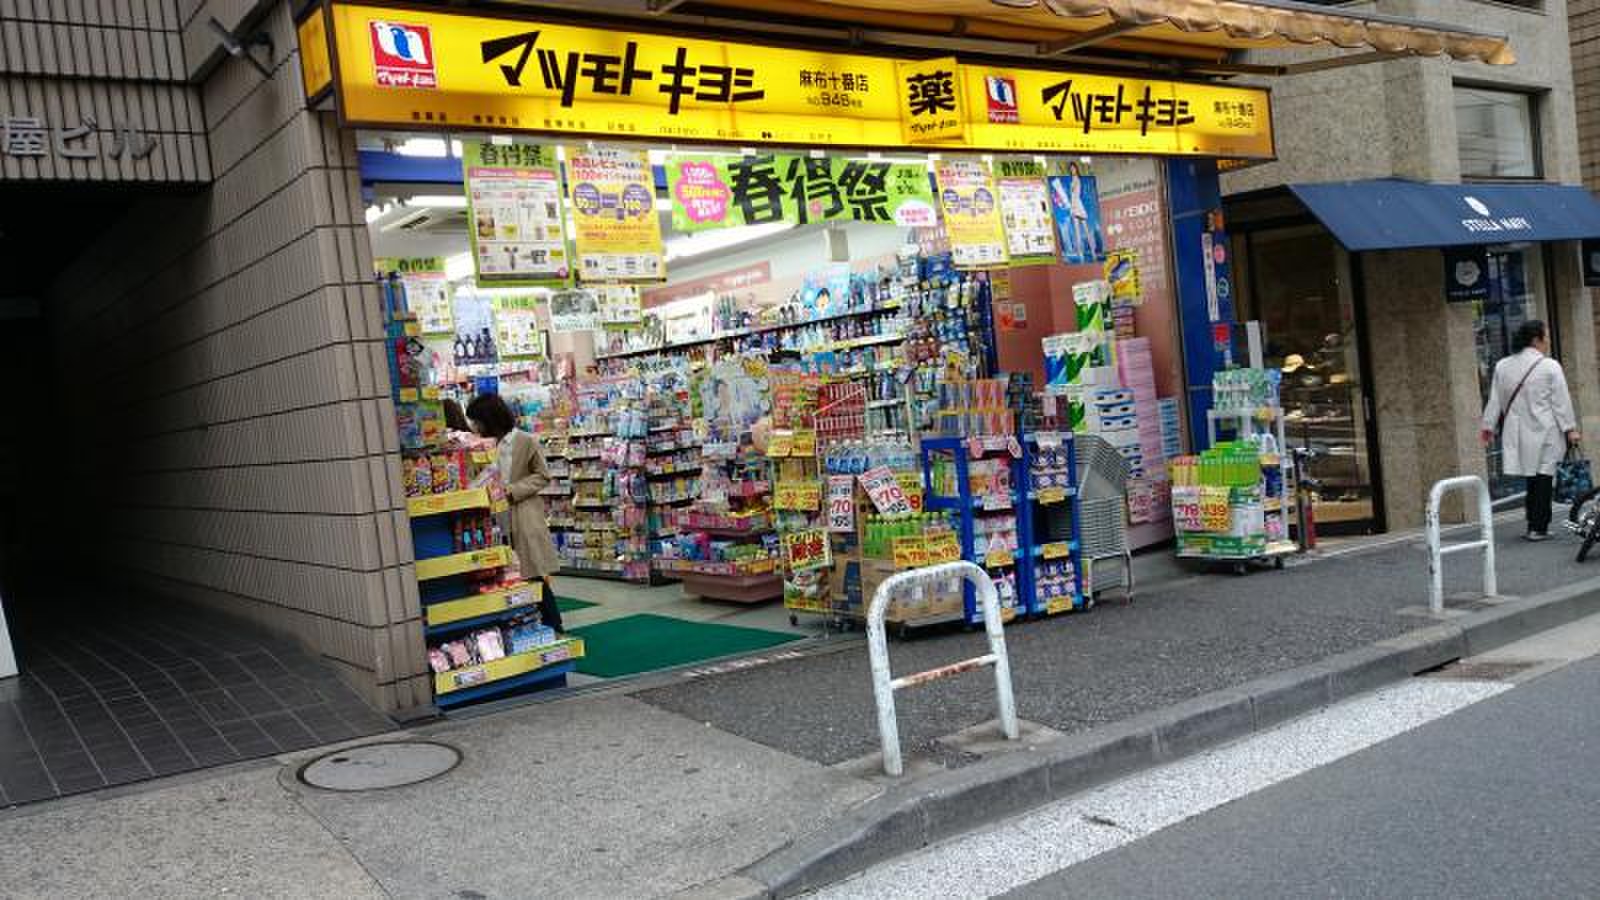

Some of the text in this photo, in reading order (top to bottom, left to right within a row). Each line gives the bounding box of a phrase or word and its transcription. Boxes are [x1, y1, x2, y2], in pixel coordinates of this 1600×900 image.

[800, 68, 870, 93] 麻布十番店
[907, 70, 955, 116] 薬
[2, 112, 158, 161] 屋ビル
[727, 155, 893, 225] 春得祭
